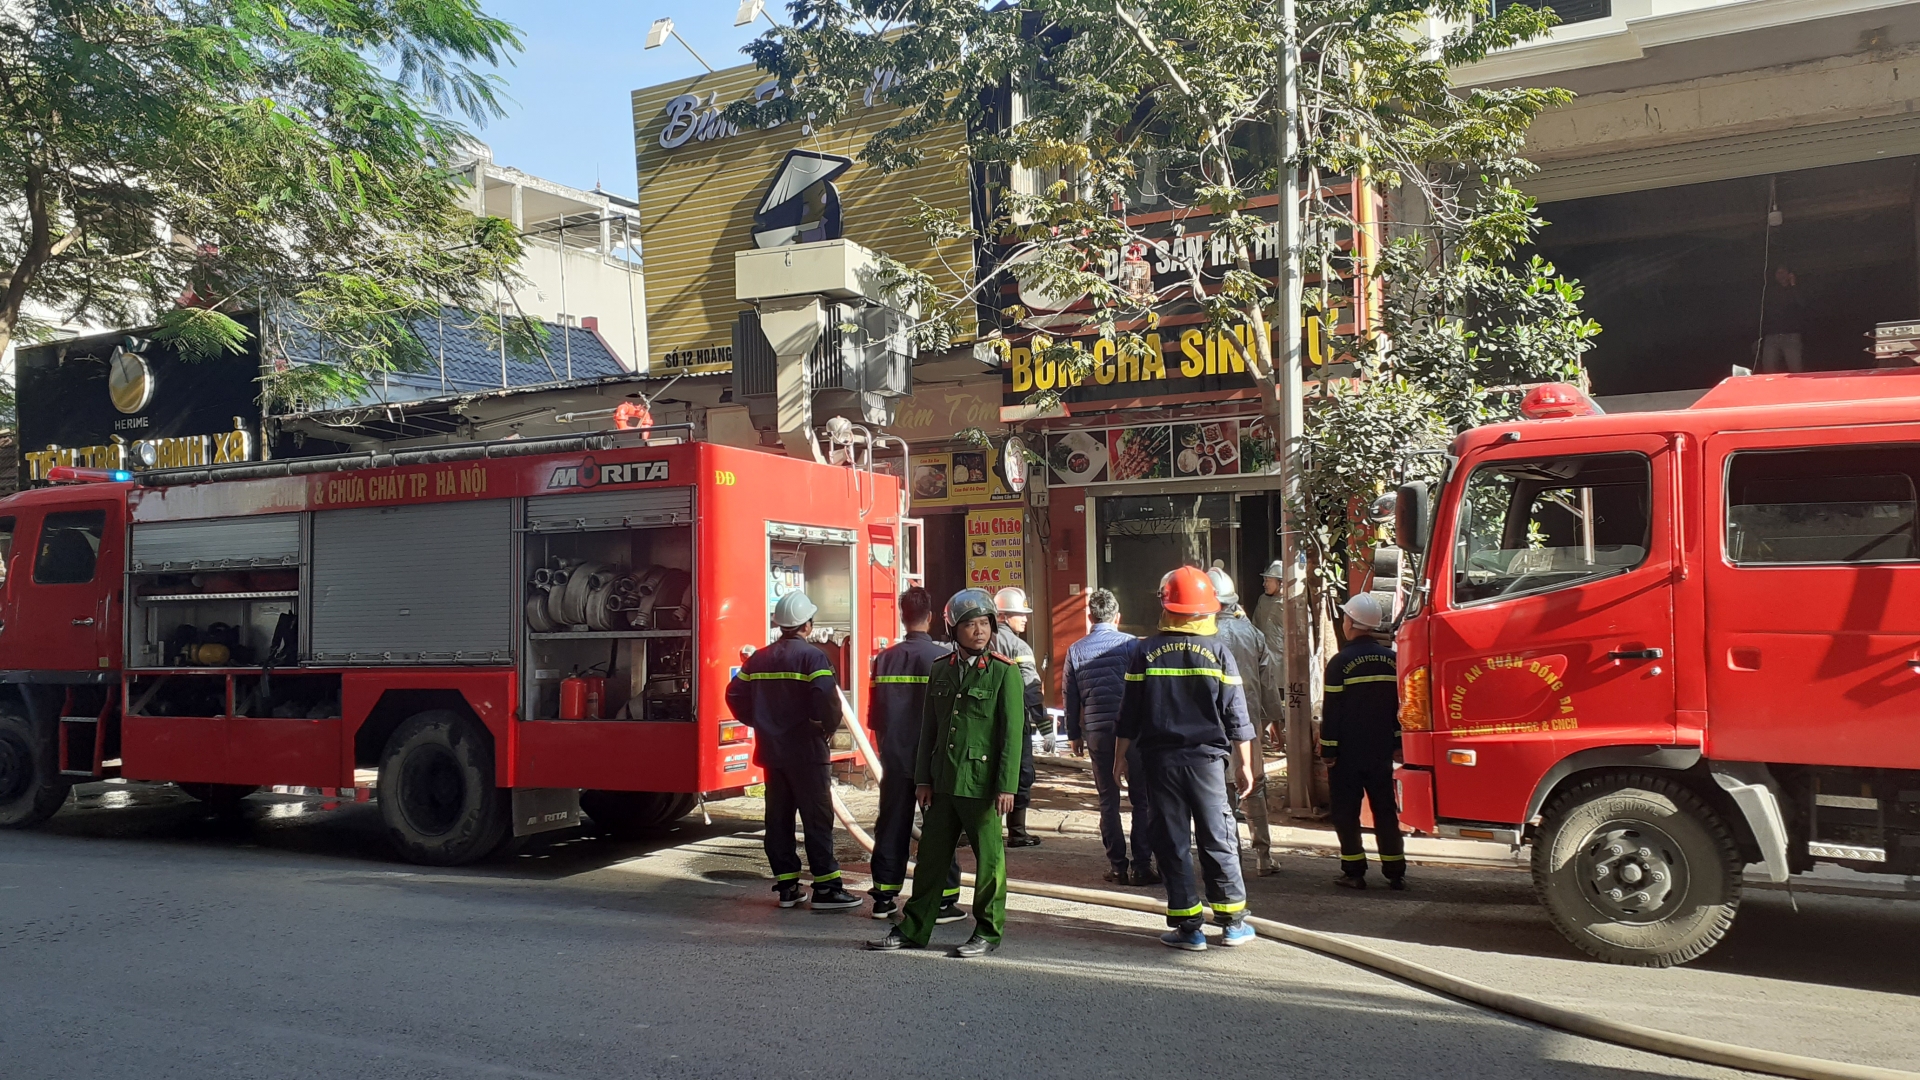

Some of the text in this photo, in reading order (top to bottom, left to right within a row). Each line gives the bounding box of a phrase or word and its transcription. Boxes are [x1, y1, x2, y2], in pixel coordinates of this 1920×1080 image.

[665, 343, 733, 368] SỐ 12 HOÀNG
[1093, 312, 1168, 386] CHẢ
[114, 416, 149, 431] HERIME
[944, 392, 999, 427] Tôm
[80, 433, 124, 469] TRÀ
[213, 416, 250, 464] XẢ
[314, 481, 325, 505] &
[328, 472, 365, 504] CHỮA
[369, 469, 406, 501] CHÁY
[409, 473, 427, 498] TP.
[436, 465, 456, 496] HÀ
[460, 463, 487, 498] NỘI
[549, 456, 669, 488] MORITA
[1161, 642, 1174, 654] SÁT
[1448, 685, 1467, 719] CÔNG
[1463, 665, 1483, 683] AN
[1486, 653, 1523, 670] QUẬN
[1529, 661, 1564, 692] ĐỐNG
[1541, 720, 1550, 732] &
[1551, 717, 1578, 731] CNCH
[526, 811, 568, 826] MRITA
